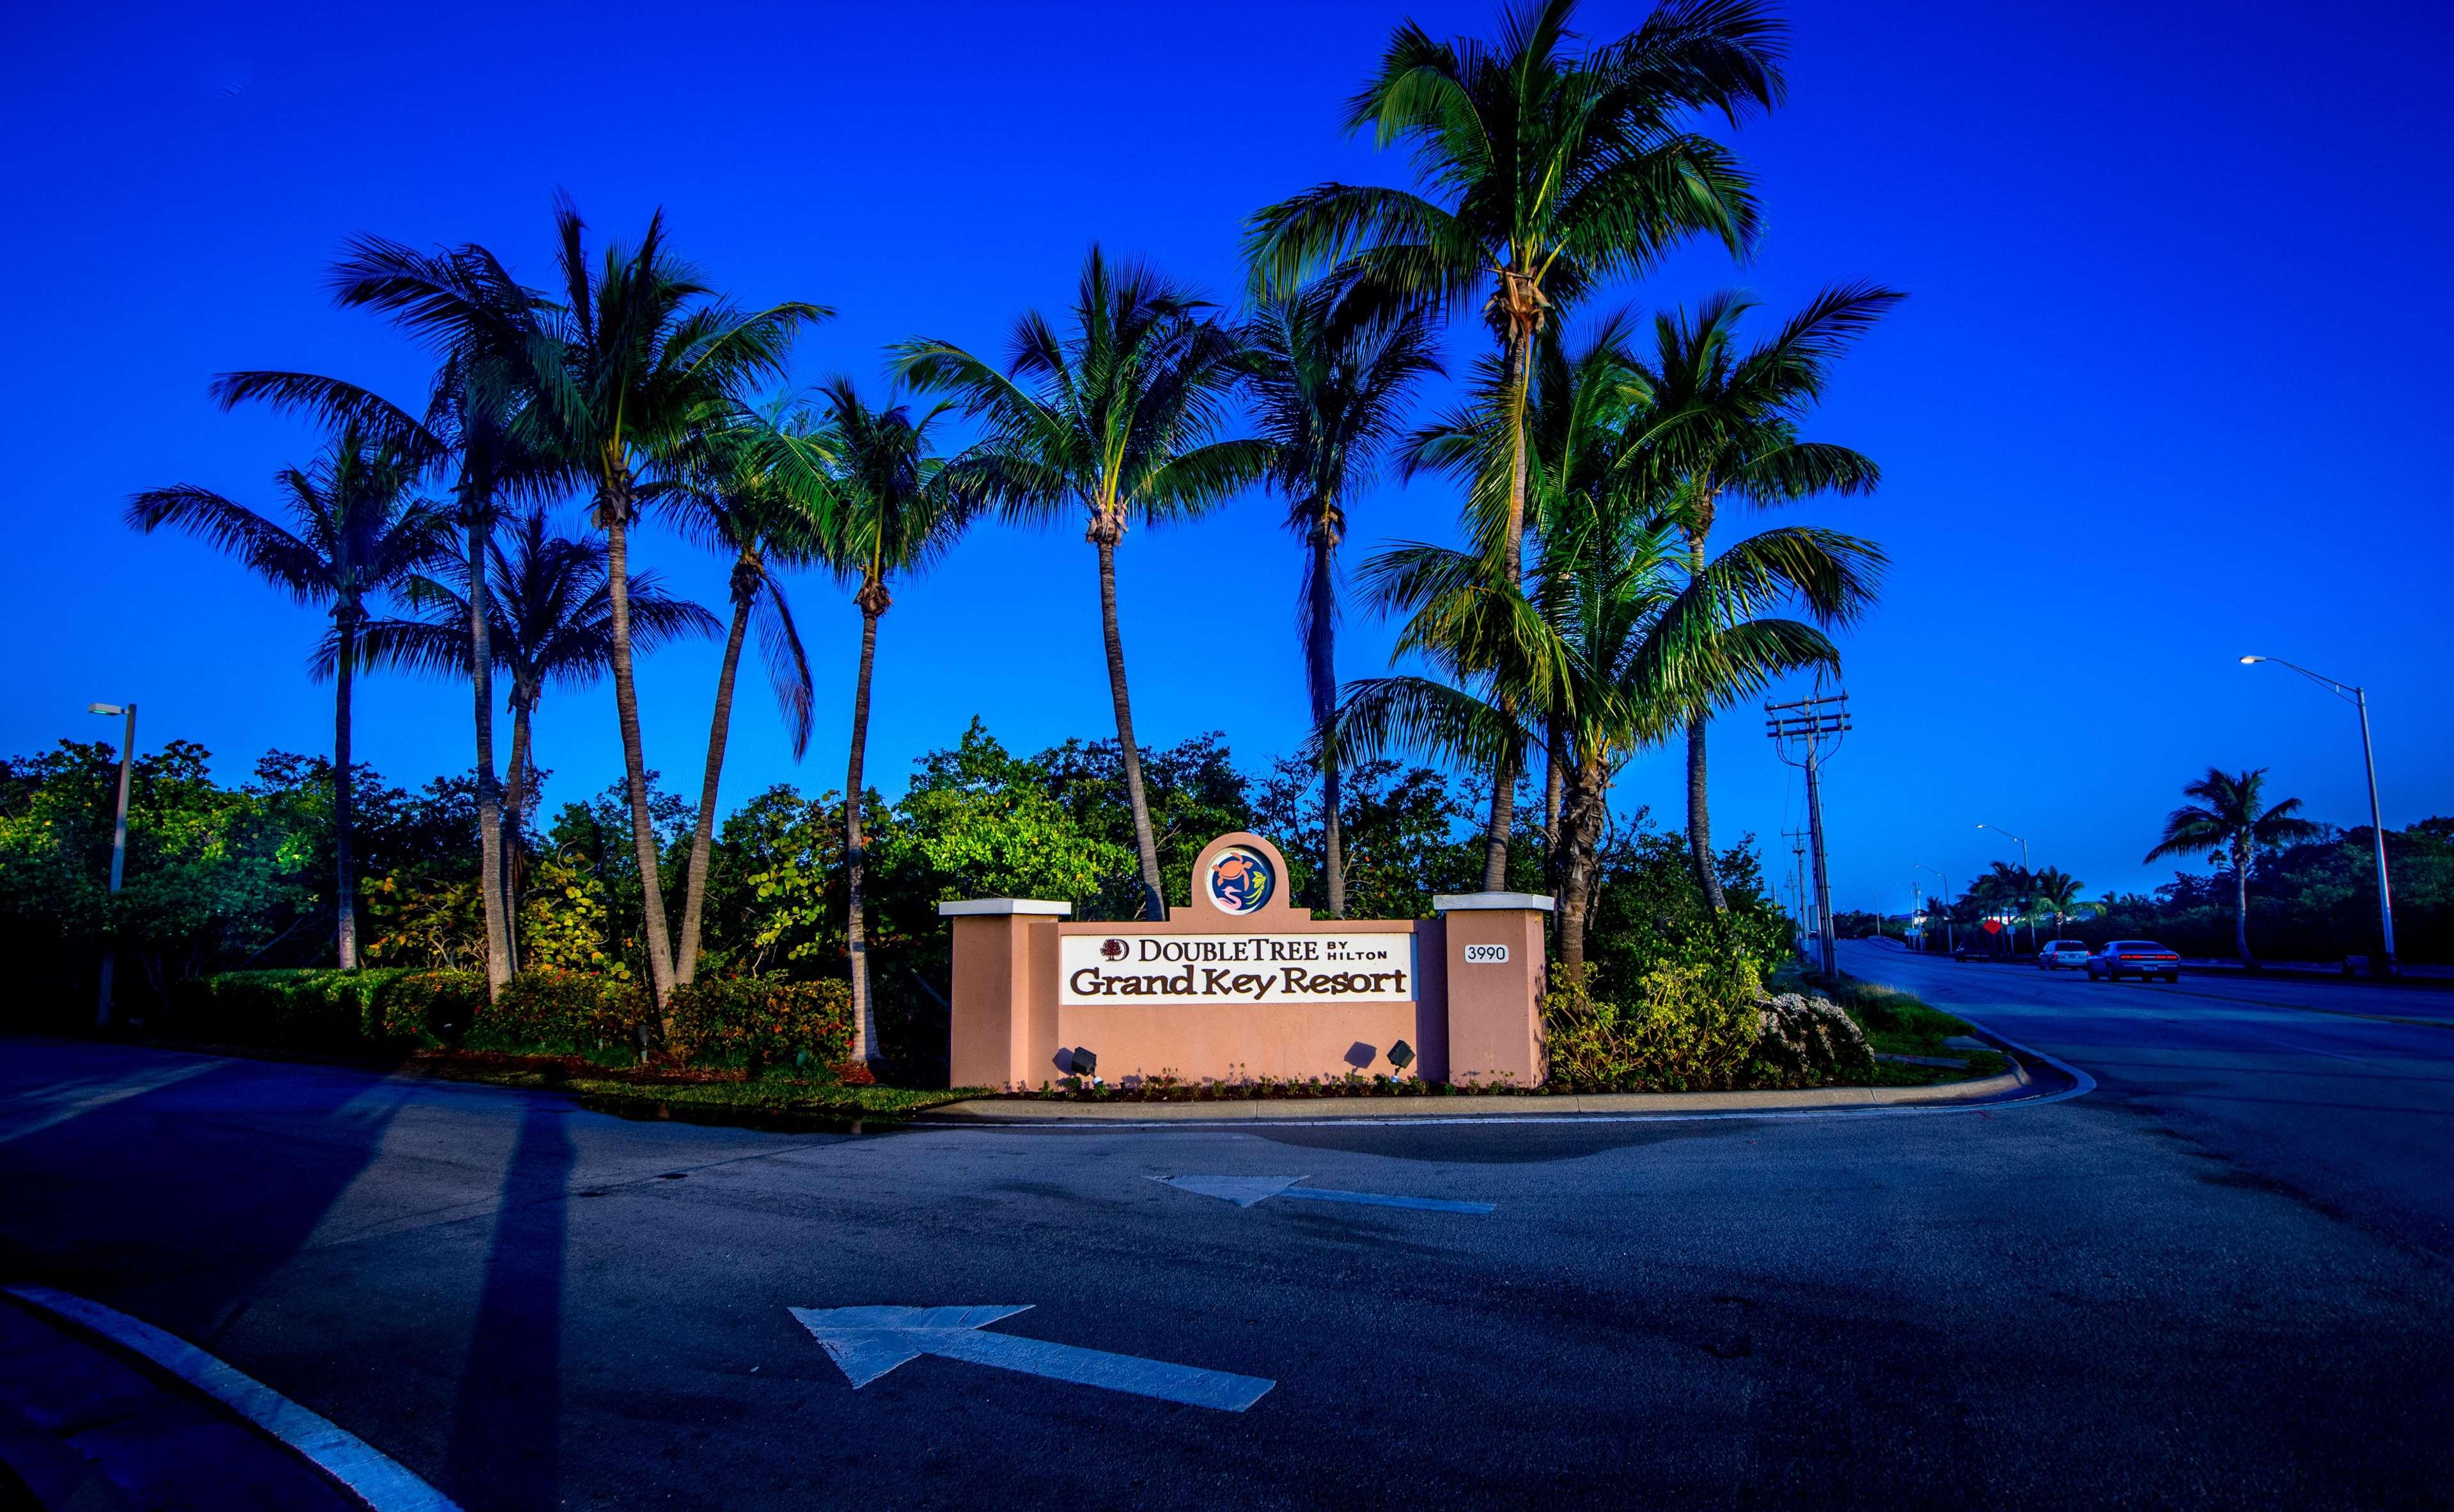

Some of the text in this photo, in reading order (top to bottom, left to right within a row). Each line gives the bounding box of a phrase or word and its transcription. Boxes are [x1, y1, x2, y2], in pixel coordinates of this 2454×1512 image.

[1327, 941, 1347, 949] BY
[1327, 951, 1387, 960] HILTON
[1467, 947, 1505, 960] 3990
[1070, 964, 1407, 1000] Grand Key Resort
